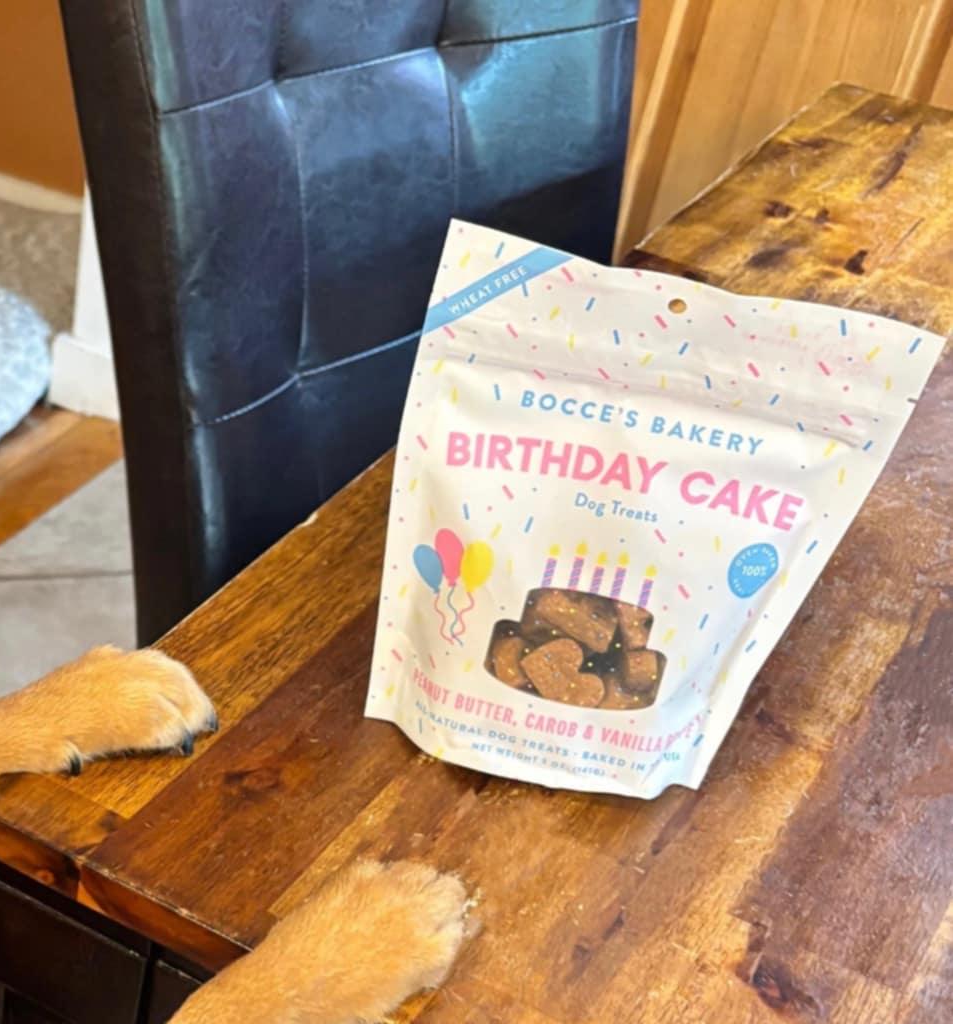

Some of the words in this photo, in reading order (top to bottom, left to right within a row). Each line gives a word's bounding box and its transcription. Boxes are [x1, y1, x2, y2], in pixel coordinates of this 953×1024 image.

[449, 284, 493, 314] WHEAT
[495, 265, 528, 289] FREE
[520, 390, 639, 428] BOCCE'S
[650, 416, 764, 455] BAKERY
[446, 431, 669, 495] BIRTHDAY
[680, 470, 805, 532] CAKE
[574, 492, 605, 517] Dog
[611, 499, 659, 523] Treats
[741, 565, 767, 577] 100%
[454, 692, 518, 727] BUTTER,
[525, 712, 579, 738] CAROB
[582, 725, 594, 740] &
[600, 727, 663, 753] VANILLA
[471, 742, 493, 753] NET
[496, 747, 538, 763] WEIGHT
[488, 730, 518, 744] DOG
[522, 738, 569, 757] TREATS
[581, 751, 627, 767] BAKED
[630, 762, 647, 772] IN
